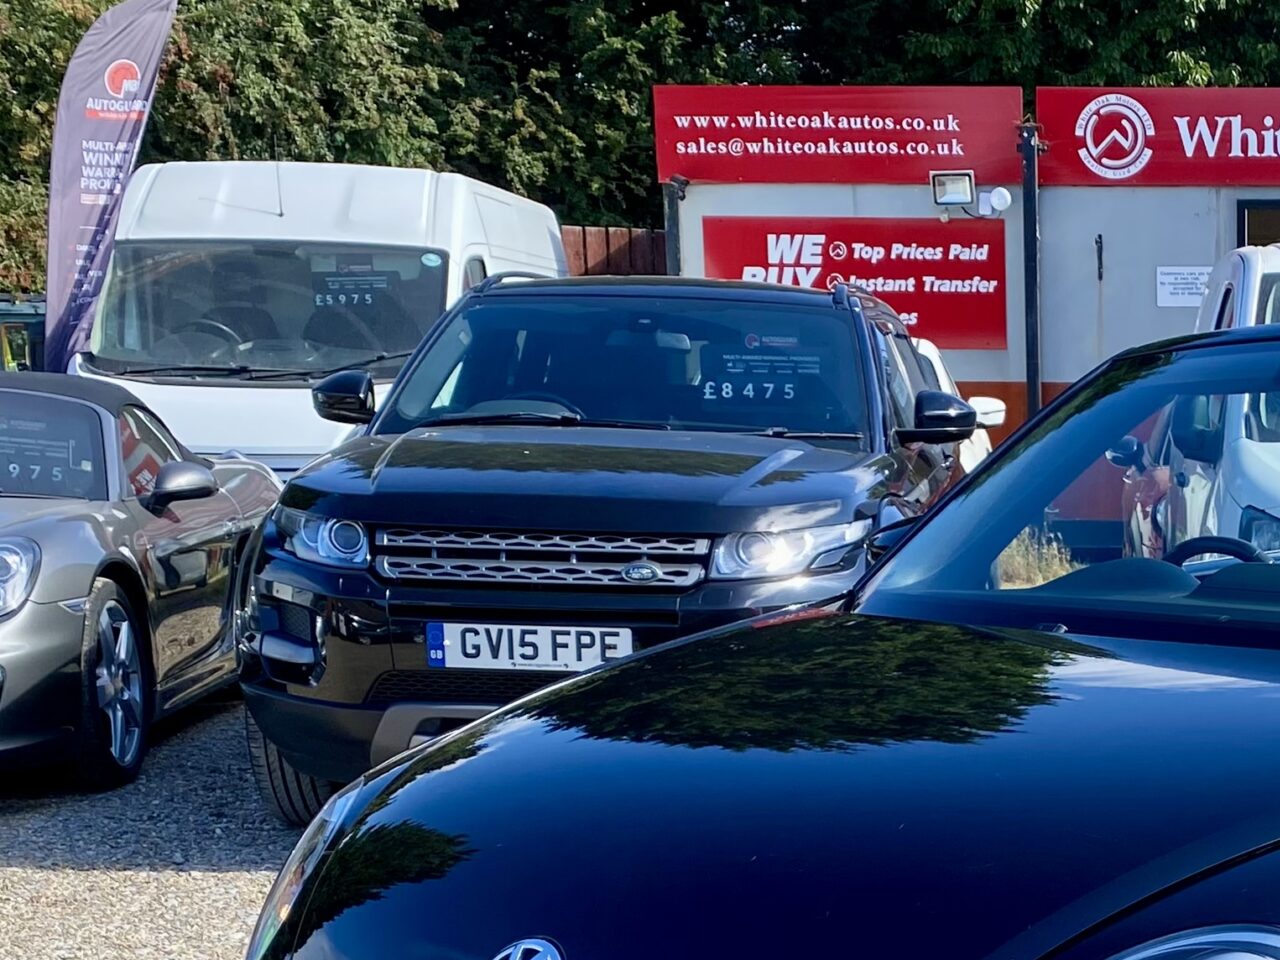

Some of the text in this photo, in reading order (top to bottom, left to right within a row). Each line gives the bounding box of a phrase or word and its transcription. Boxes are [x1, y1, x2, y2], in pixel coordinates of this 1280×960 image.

[673, 111, 960, 132] www.whiteoakautos.co.uk
[676, 137, 964, 156] sales@whiteoakautos.co.uk
[767, 233, 826, 264] WE
[851, 243, 989, 263] Top Prices Paid
[850, 275, 998, 294] Instant Transfer
[315, 293, 372, 306] £5975
[703, 381, 795, 399] £8475
[460, 627, 621, 662] GV15 FPE
[430, 650, 443, 659] GB
